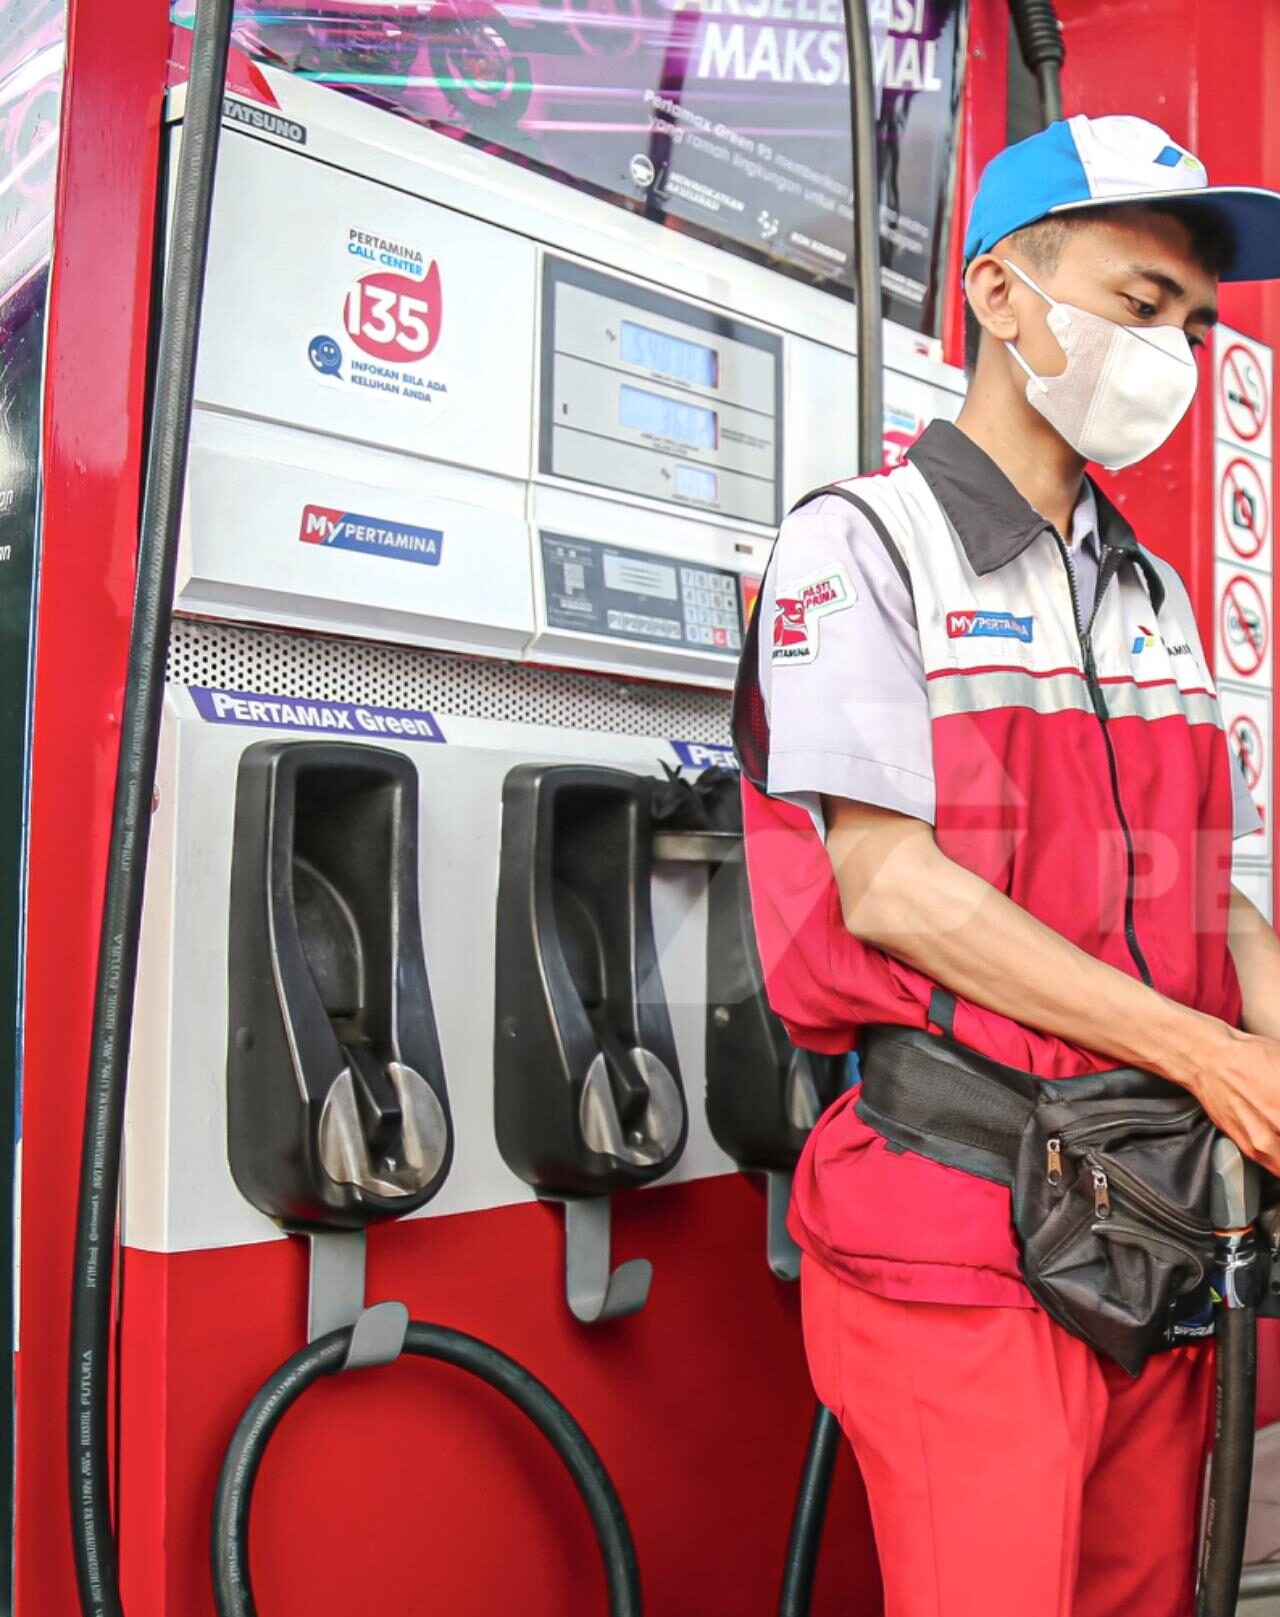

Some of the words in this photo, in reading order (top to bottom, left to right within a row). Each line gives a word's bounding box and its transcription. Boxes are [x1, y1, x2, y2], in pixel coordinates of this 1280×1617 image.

[223, 102, 303, 141] TATSUNO
[644, 89, 712, 132] Pertamax
[714, 123, 754, 152] Green
[347, 242, 376, 262] CALL
[379, 253, 423, 276] CENTER
[349, 229, 424, 263] PERTAMINA
[348, 281, 430, 353] 135
[351, 360, 399, 381] INFOKAN
[402, 373, 424, 388] BILA
[427, 378, 448, 393] ADA
[351, 374, 400, 395] KELUHAN
[402, 387, 432, 403] ANDA
[211, 692, 355, 730] PERTAMAX
[355, 708, 435, 737] Green
[80, 1349, 93, 1406] FUTURA
